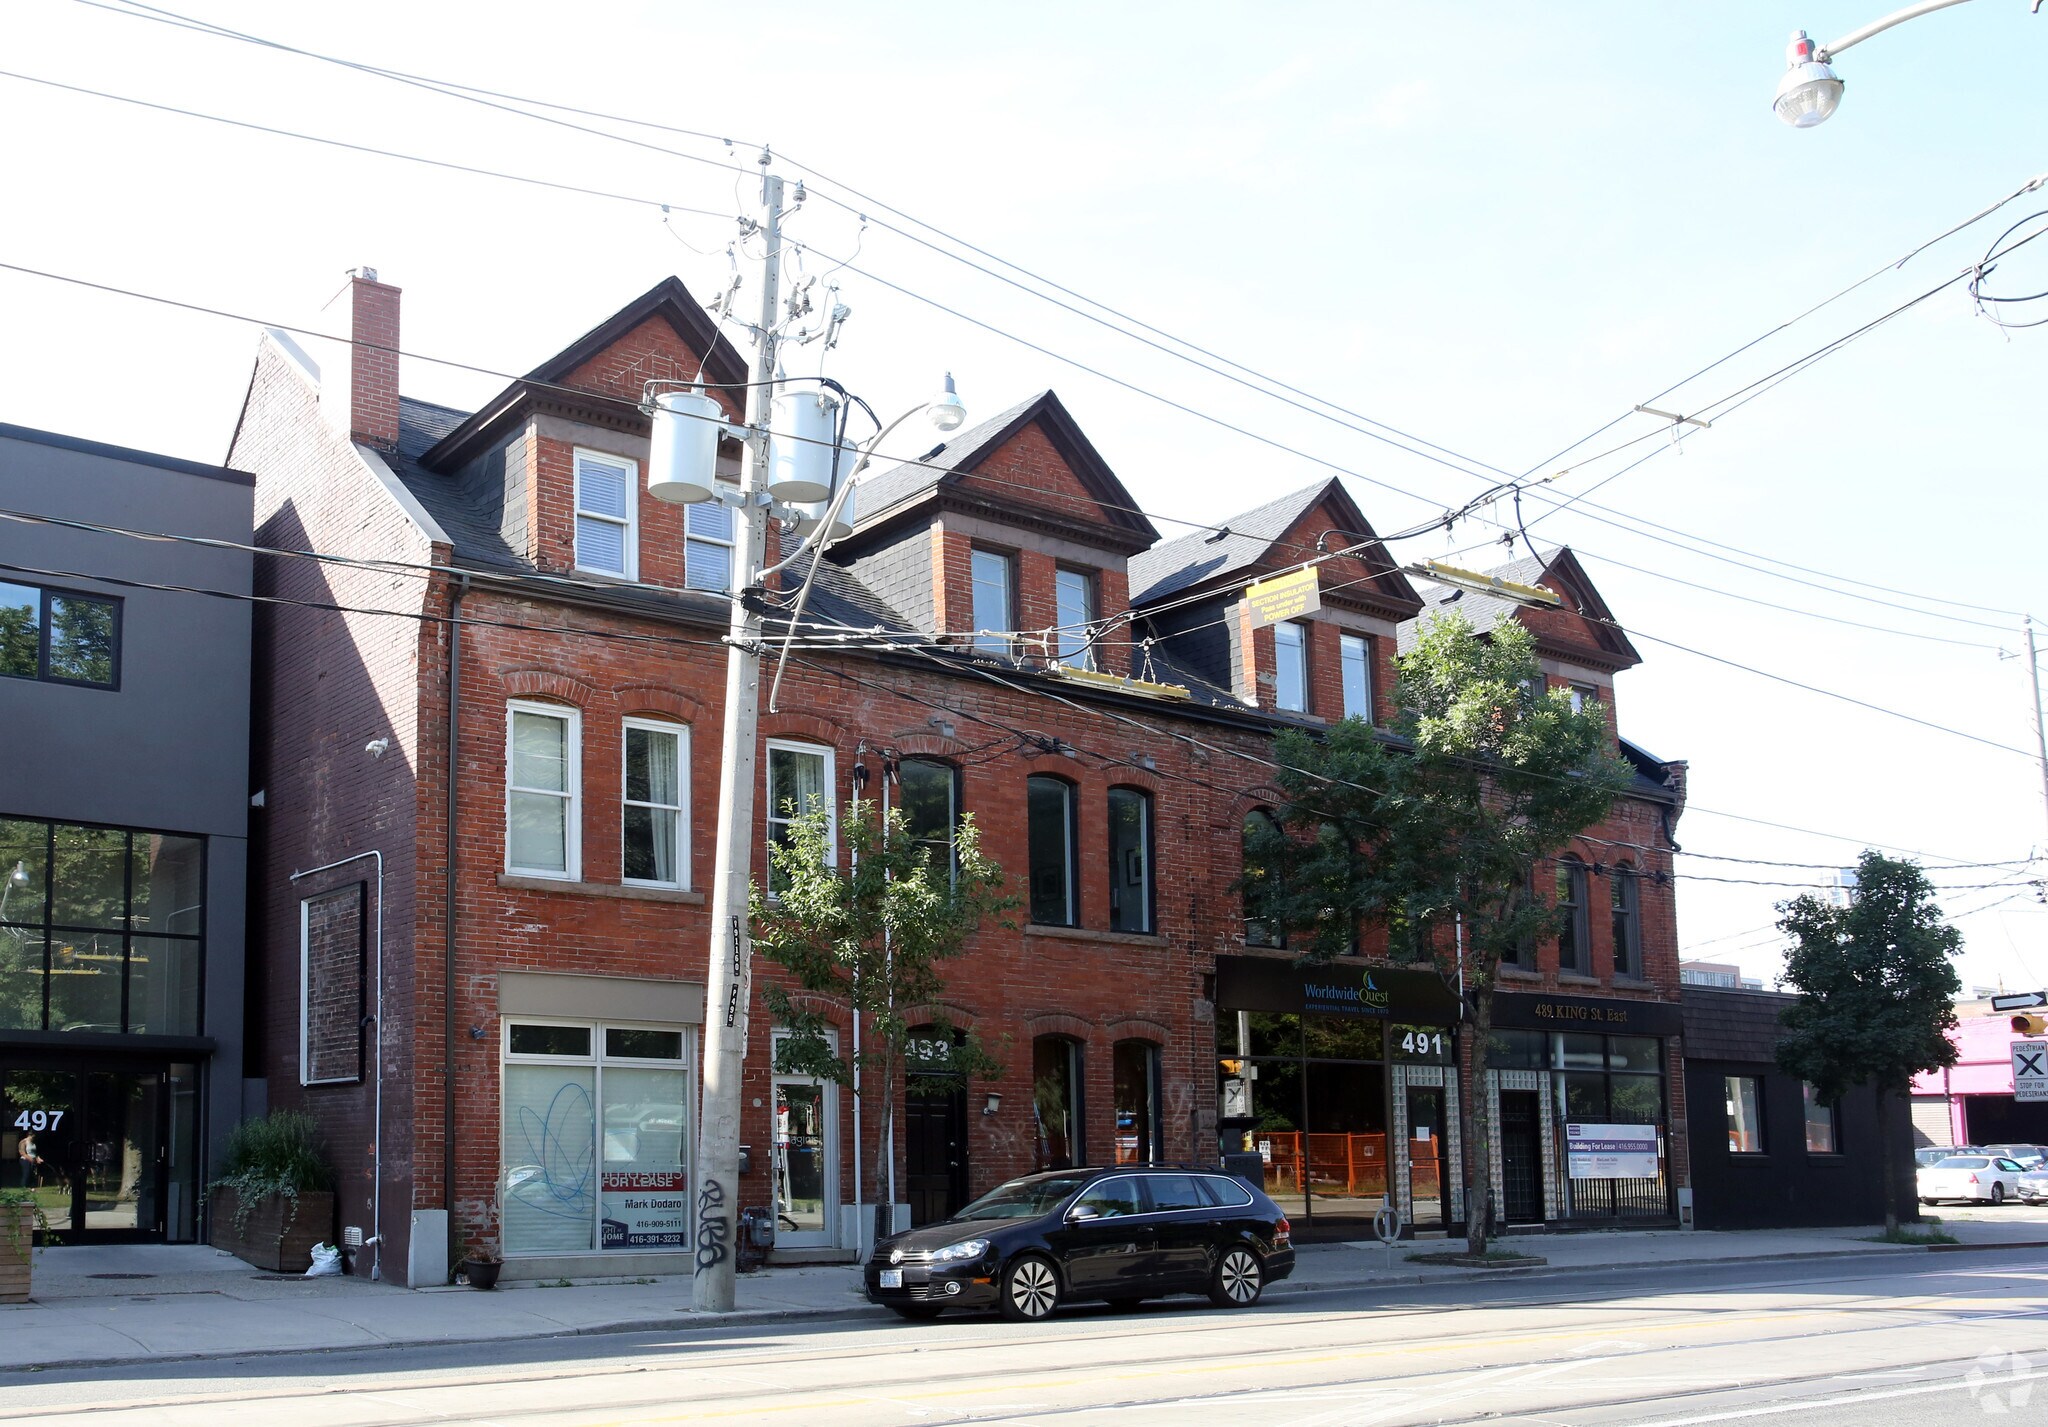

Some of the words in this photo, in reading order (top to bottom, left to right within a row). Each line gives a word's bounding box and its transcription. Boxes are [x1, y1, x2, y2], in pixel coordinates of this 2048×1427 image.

[1251, 593, 1279, 607] SECTION
[1279, 582, 1315, 600] INSULATOR
[1276, 600, 1293, 609] under
[1294, 594, 1307, 603] with
[1264, 609, 1289, 622] POWER
[1290, 603, 1305, 614] OFF
[1341, 1005, 1360, 1013] TRAVEL
[1556, 1005, 1587, 1019] KING
[1606, 1009, 1628, 1022] East
[1401, 1032, 1441, 1054] 491
[14, 1110, 64, 1131] 497
[1569, 1142, 1591, 1151] Building
[1592, 1142, 1601, 1150] For
[1601, 1142, 1616, 1150] Lease
[601, 1177, 629, 1187] FOR
[632, 1177, 674, 1187] LEASE
[625, 1199, 648, 1208] Mark
[650, 1199, 682, 1209] Dodaro
[636, 1220, 681, 1228] 416-909-5111
[629, 1234, 680, 1244] 416-391-3232
